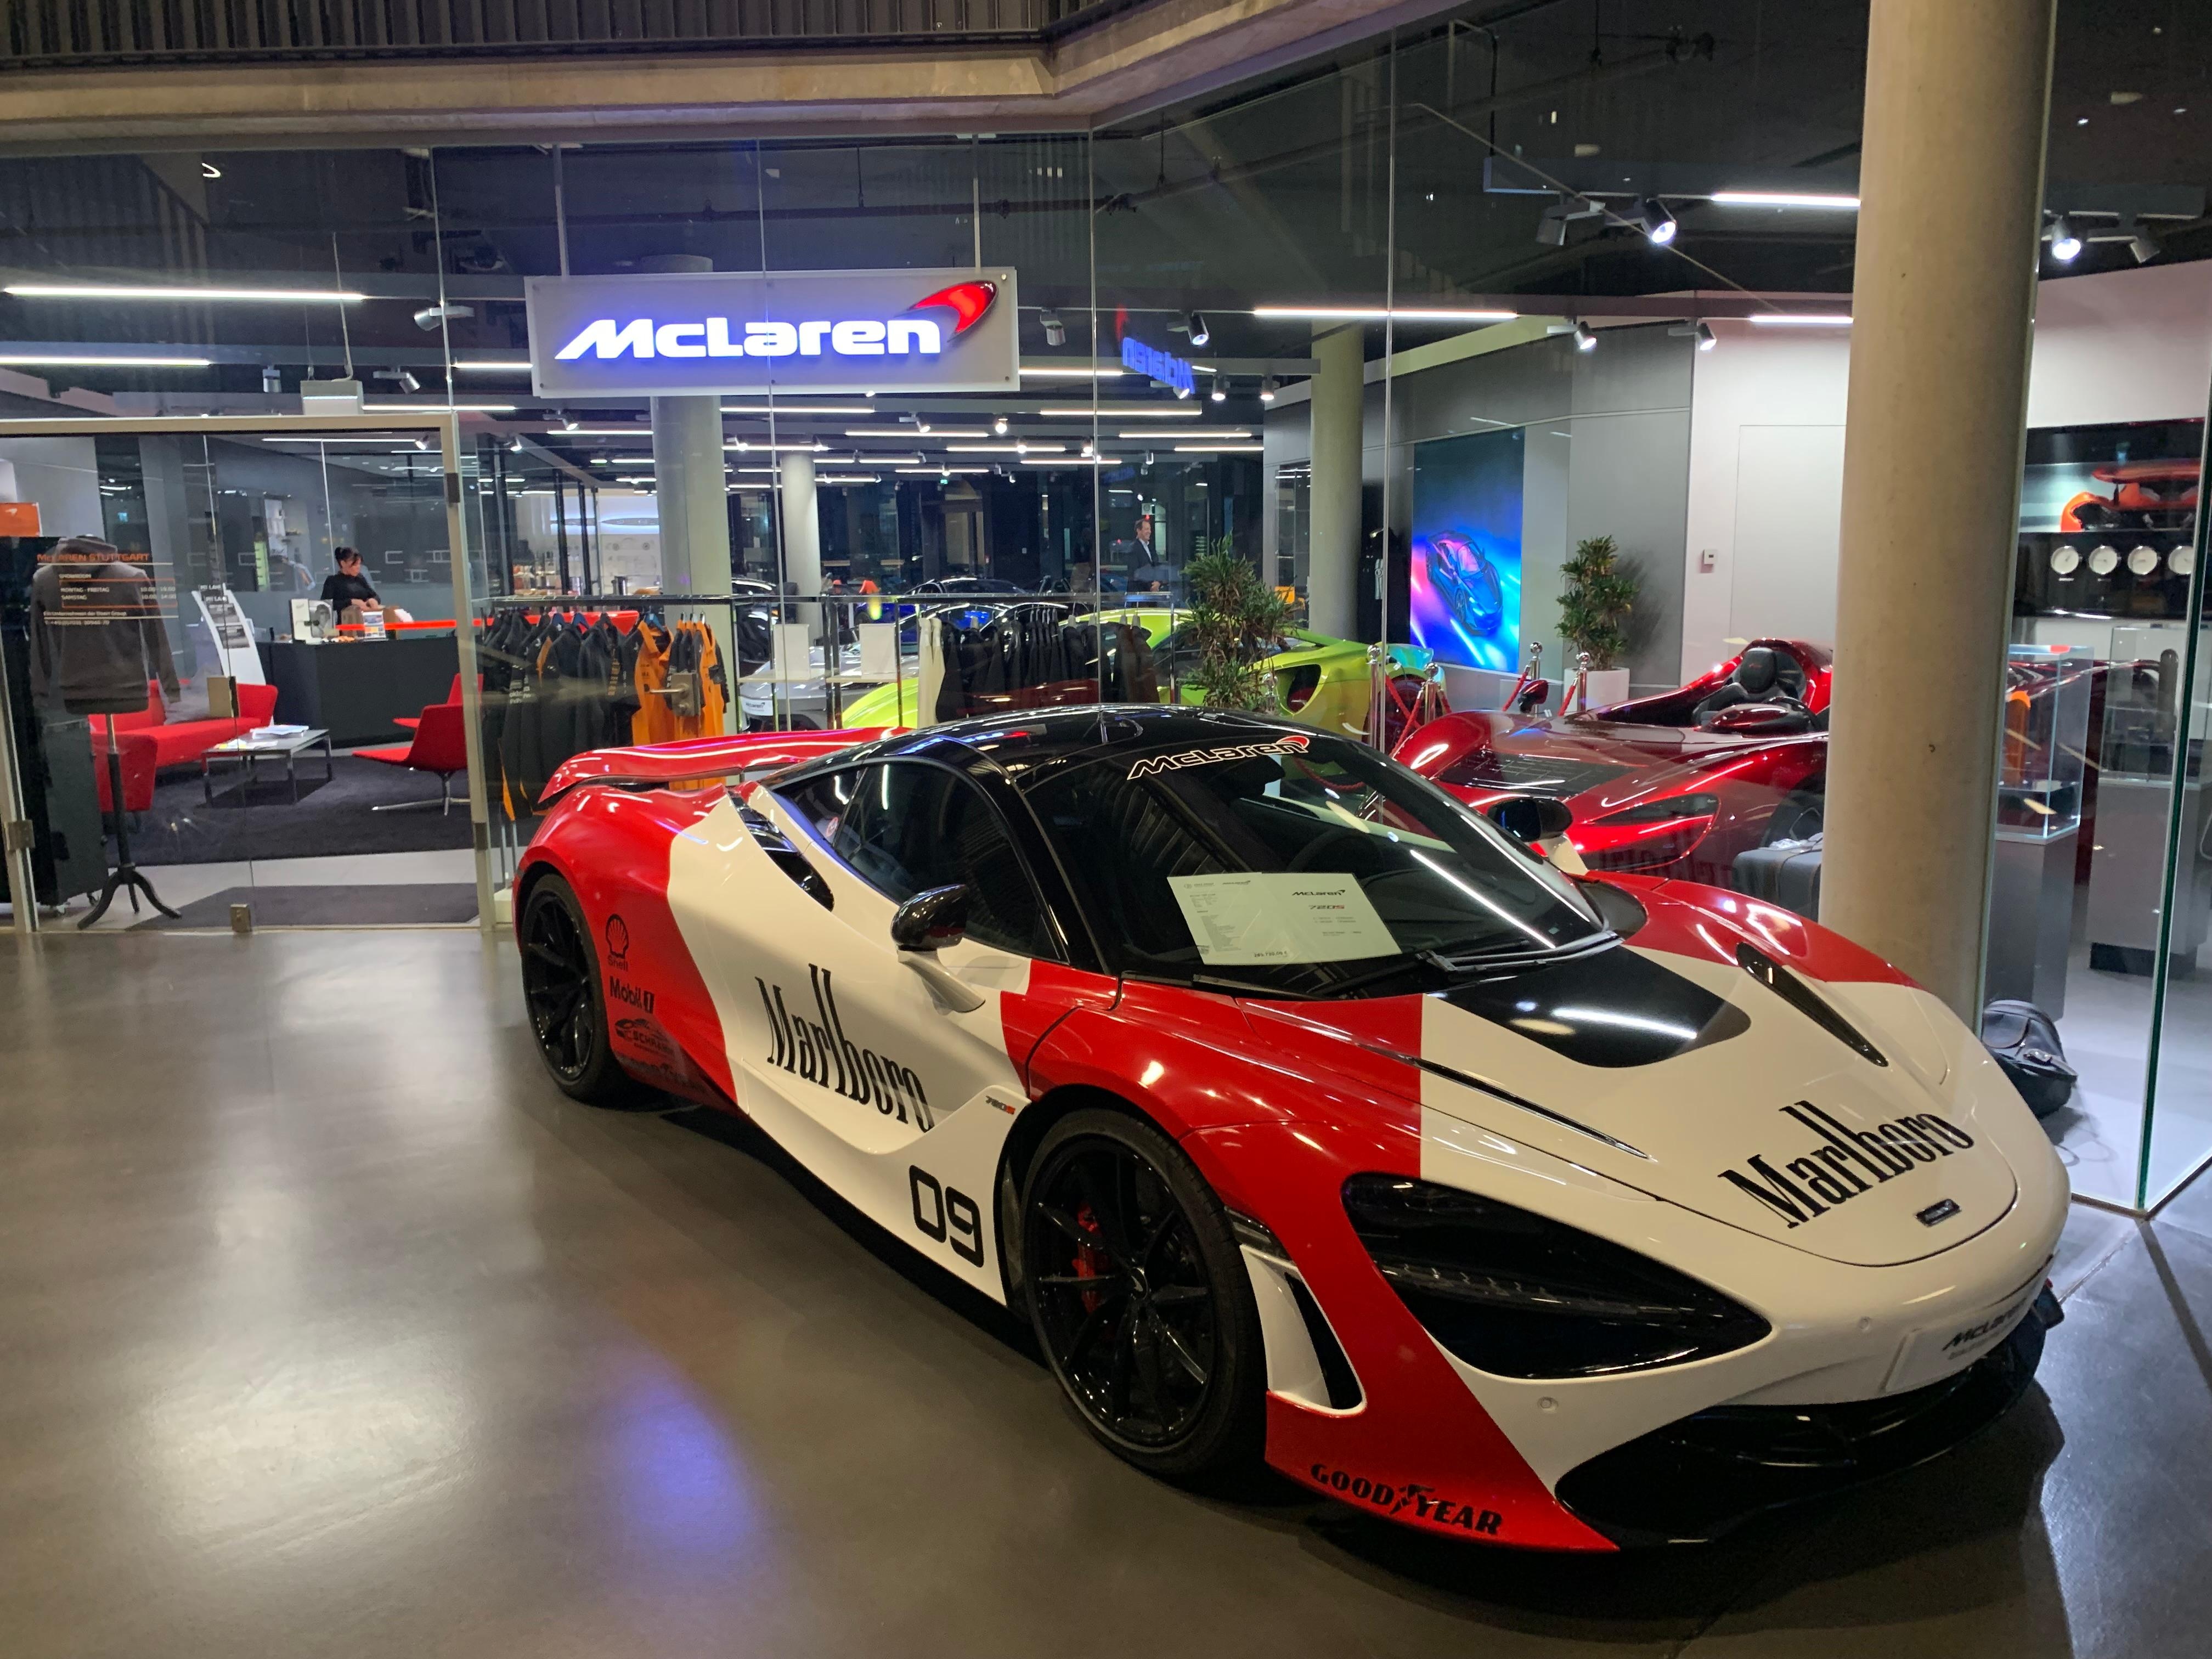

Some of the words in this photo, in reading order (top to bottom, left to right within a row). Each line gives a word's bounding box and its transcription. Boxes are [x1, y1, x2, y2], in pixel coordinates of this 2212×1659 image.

[554, 317, 941, 359] McLaren
[89, 553, 149, 561] STUTTGART
[1126, 742, 1310, 781] McLaren
[607, 954, 628, 972] Shell
[609, 975, 642, 1010] Mobil
[755, 963, 935, 1134] Marlboro
[1717, 1100, 1975, 1229] Marlboro
[909, 1164, 985, 1268] 09
[1310, 1463, 1502, 1536] GOODYEAR
